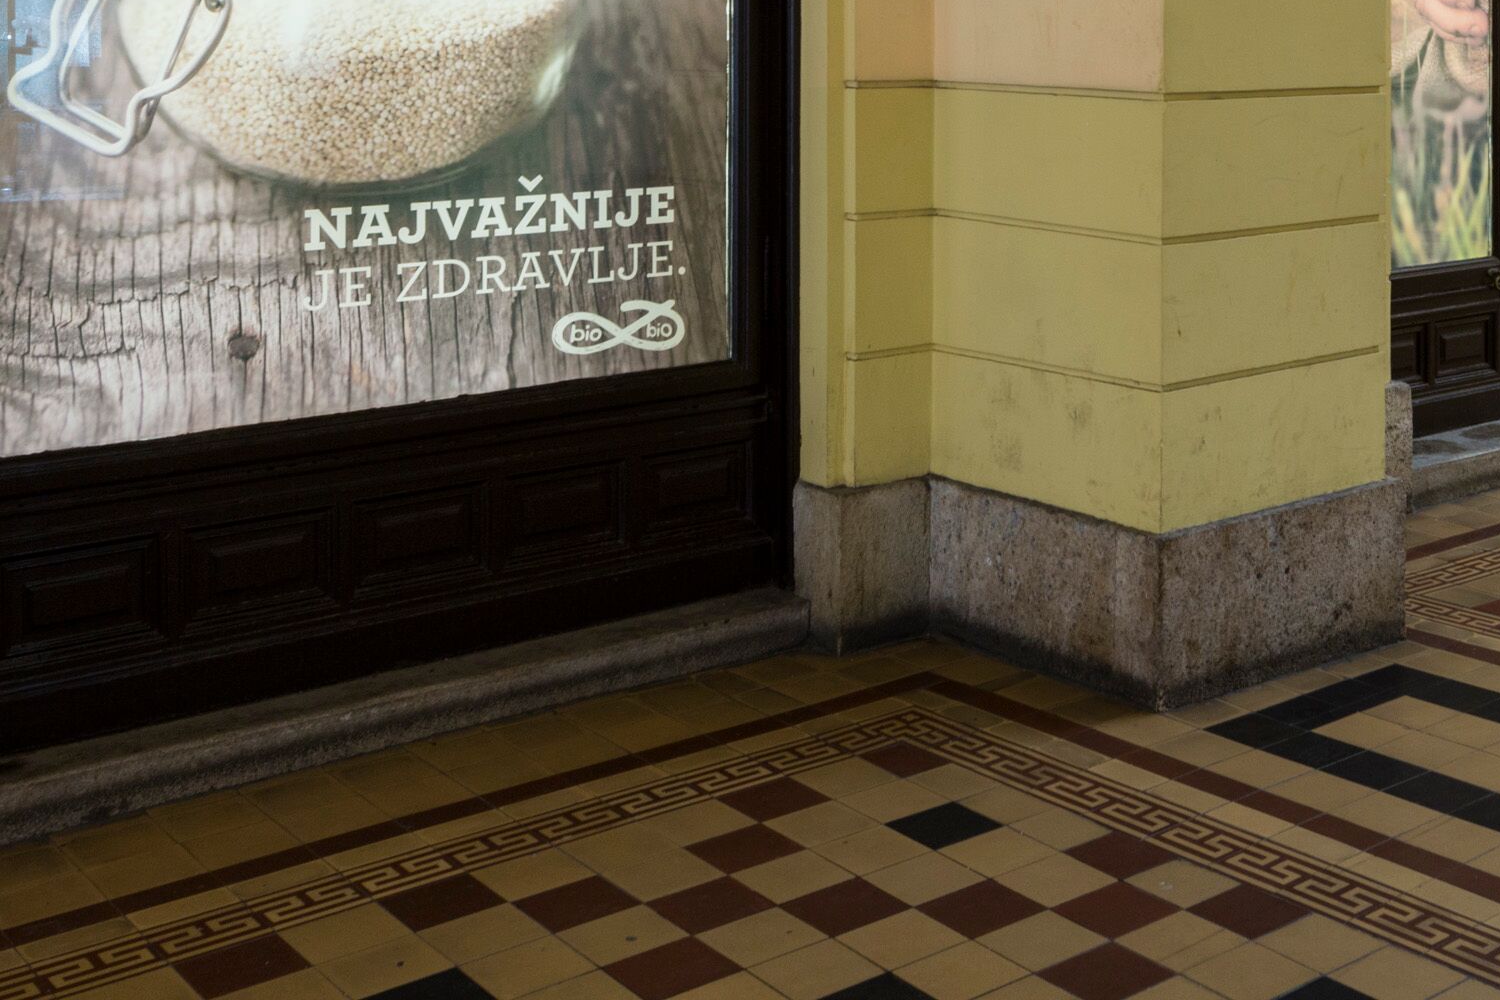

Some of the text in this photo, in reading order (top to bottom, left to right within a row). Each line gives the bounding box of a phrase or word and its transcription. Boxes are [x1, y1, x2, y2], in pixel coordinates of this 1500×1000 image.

[303, 173, 676, 252] NAJVAŽNIJE
[302, 240, 687, 312] JE ZDRAVLJE.
[569, 323, 603, 344] bio
